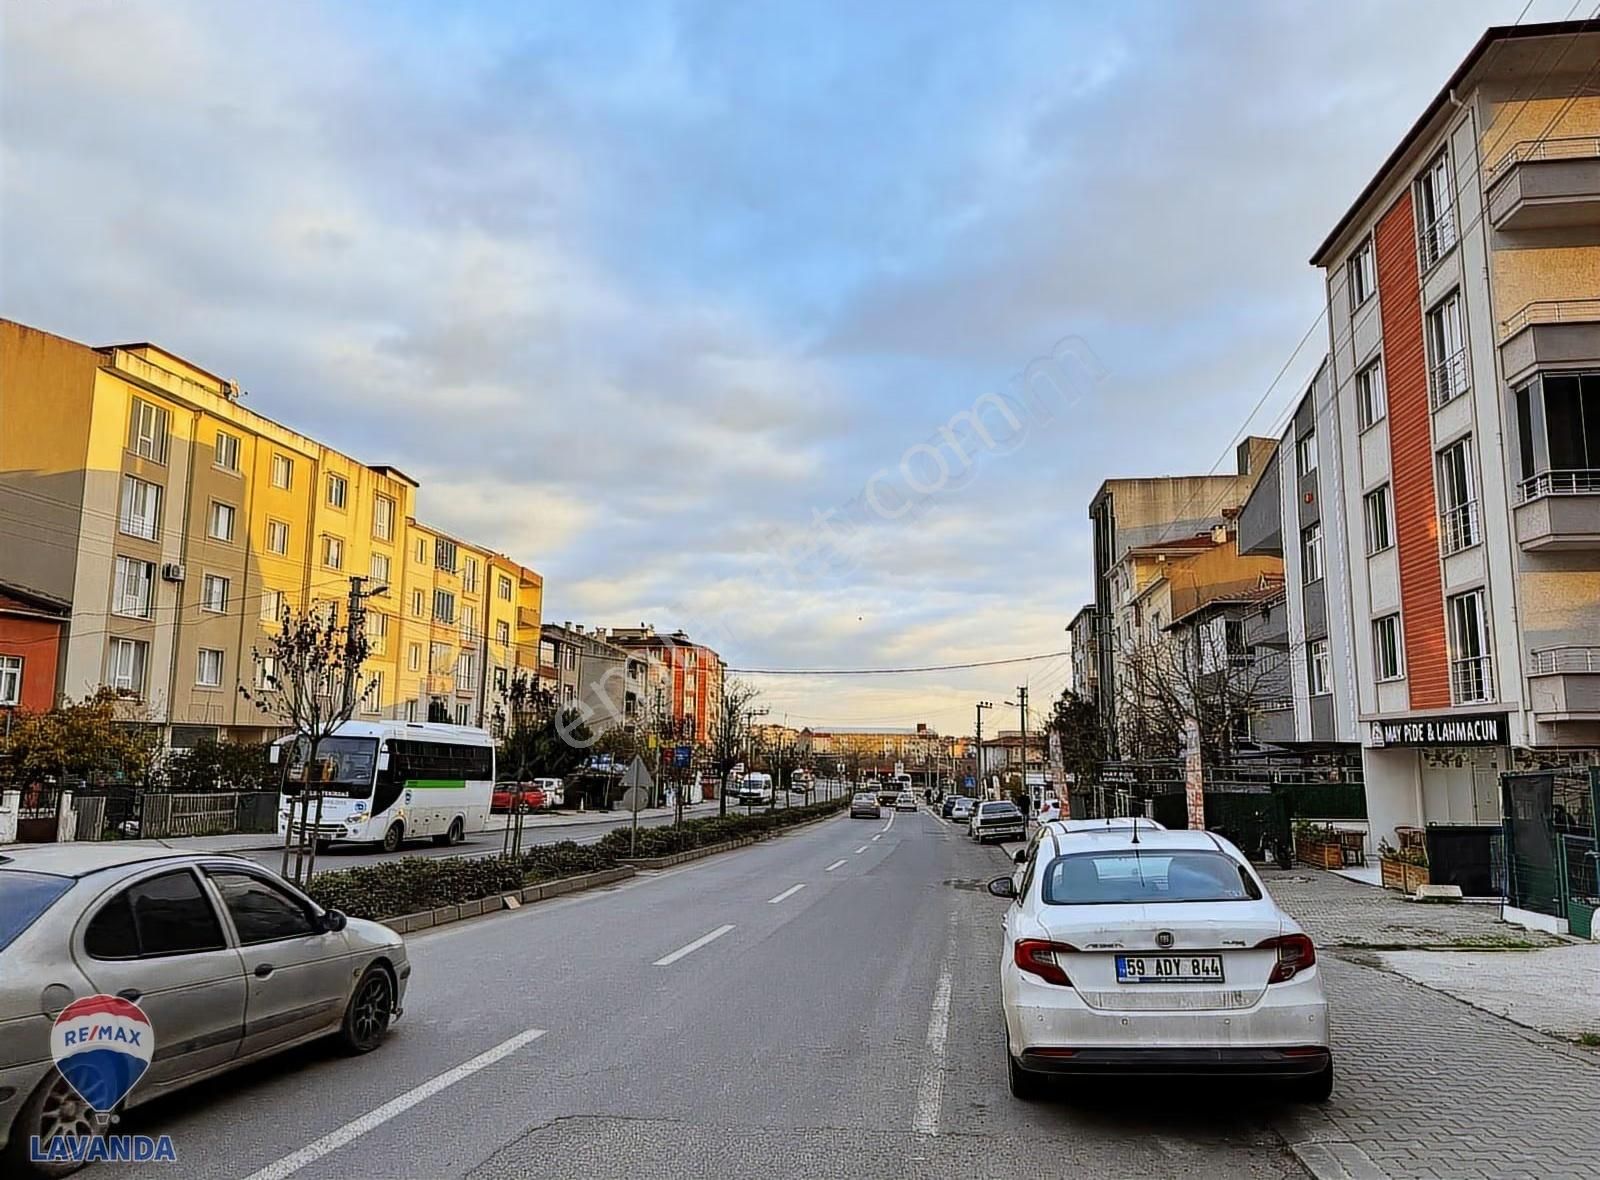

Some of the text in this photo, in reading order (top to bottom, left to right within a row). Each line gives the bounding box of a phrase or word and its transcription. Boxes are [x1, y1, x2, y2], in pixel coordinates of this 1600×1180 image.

[1385, 725, 1401, 743] MAY
[1427, 722, 1435, 741] &
[1436, 720, 1498, 742] LAHMACUN
[1126, 959, 1145, 976] 59
[1155, 959, 1181, 976] ADY
[1191, 959, 1220, 976] 844
